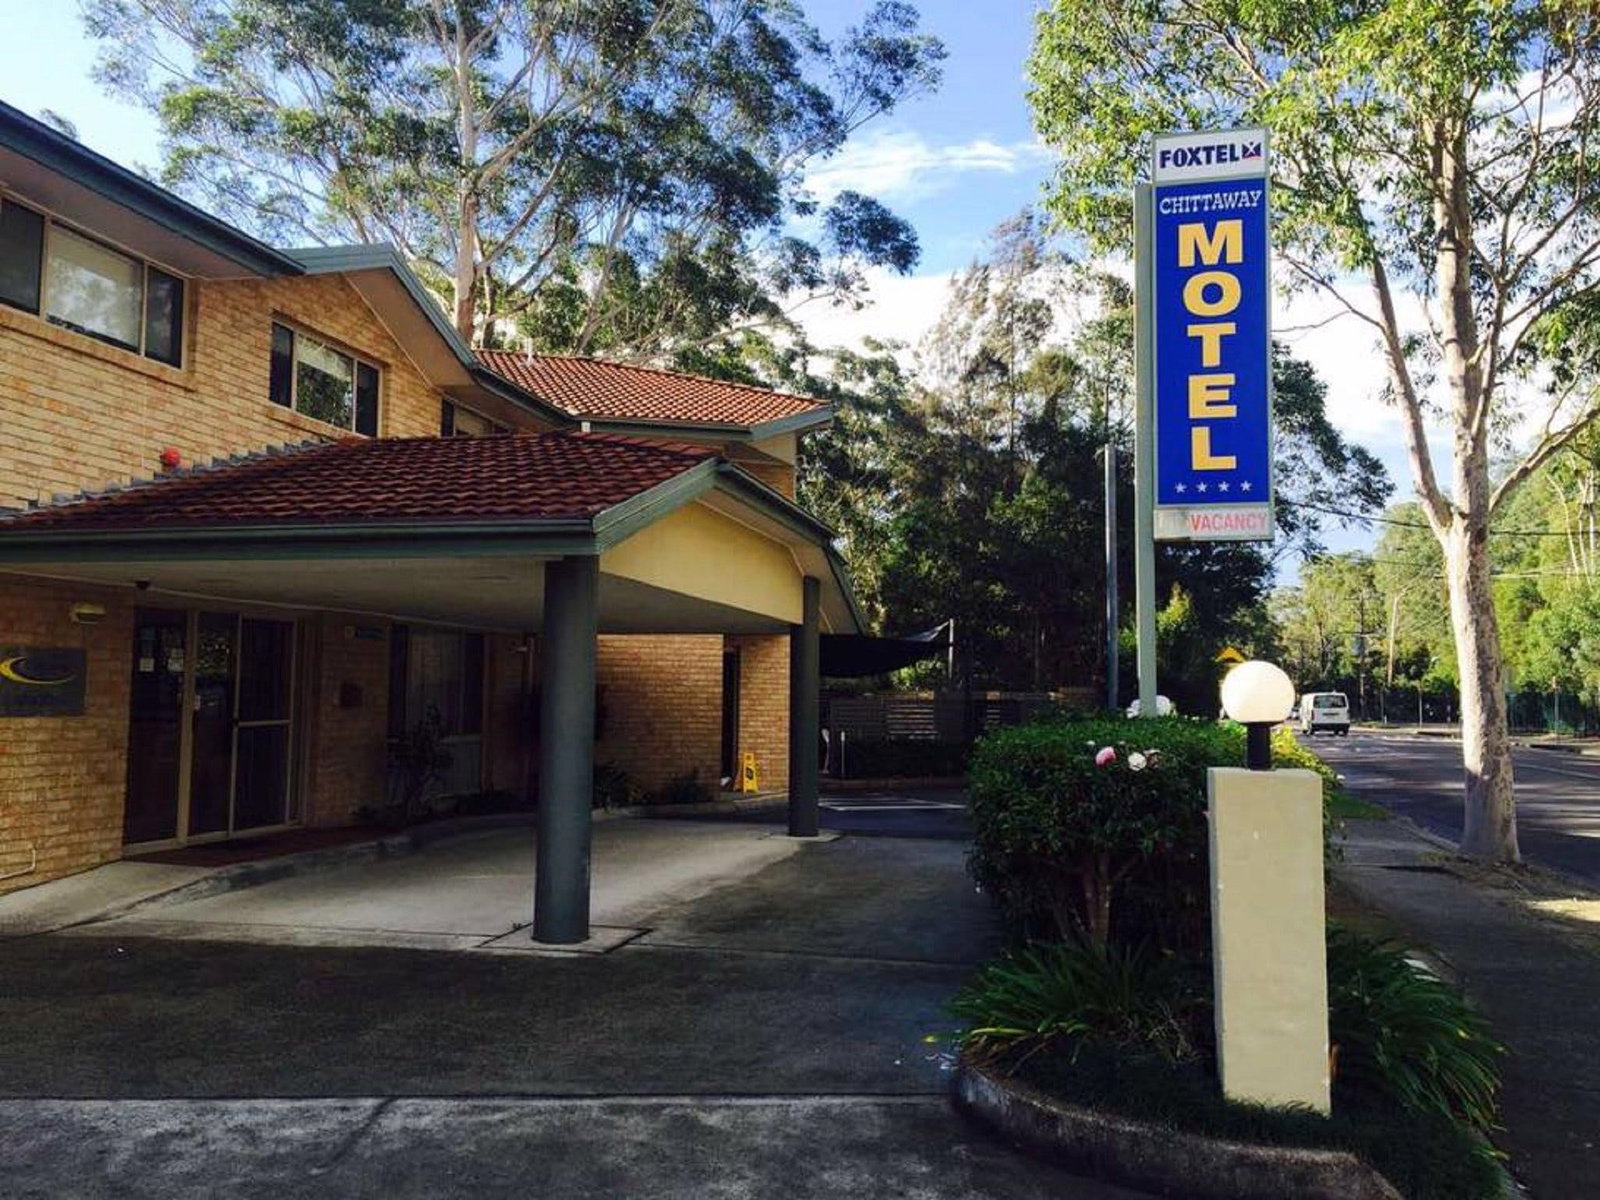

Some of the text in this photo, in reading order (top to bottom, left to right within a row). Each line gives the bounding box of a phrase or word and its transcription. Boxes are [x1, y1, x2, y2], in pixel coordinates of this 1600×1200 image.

[1160, 144, 1239, 168] FOXTEL
[1160, 190, 1262, 213] CHITTAWAY
[1179, 219, 1243, 470] MOTEL
[1190, 513, 1266, 531] VACANCY
